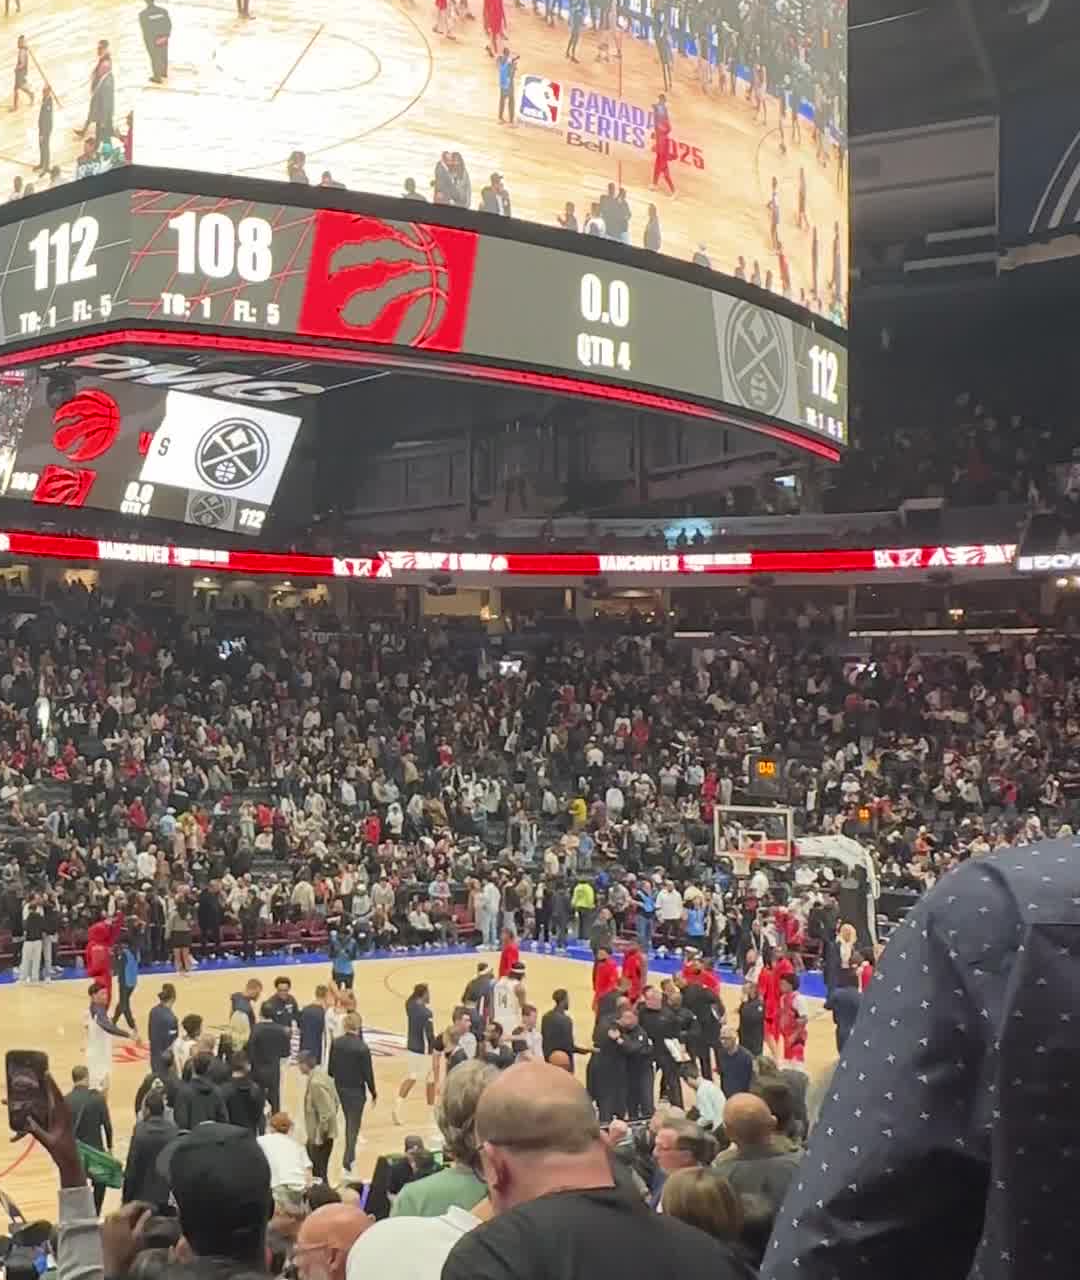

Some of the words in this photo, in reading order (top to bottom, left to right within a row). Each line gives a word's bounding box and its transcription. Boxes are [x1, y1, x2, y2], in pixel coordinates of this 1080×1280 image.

[566, 131, 610, 155] Bell
[568, 108, 646, 149] SERIES
[28, 216, 99, 291] 112
[169, 211, 273, 282] 108
[47, 306, 57, 328] 1
[201, 297, 211, 318] 1
[266, 303, 281, 326] 5
[580, 273, 630, 327] 0.0
[577, 332, 614, 367] QTR
[617, 341, 631, 370] 4
[809, 345, 839, 404] 112
[239, 506, 267, 528] 112
